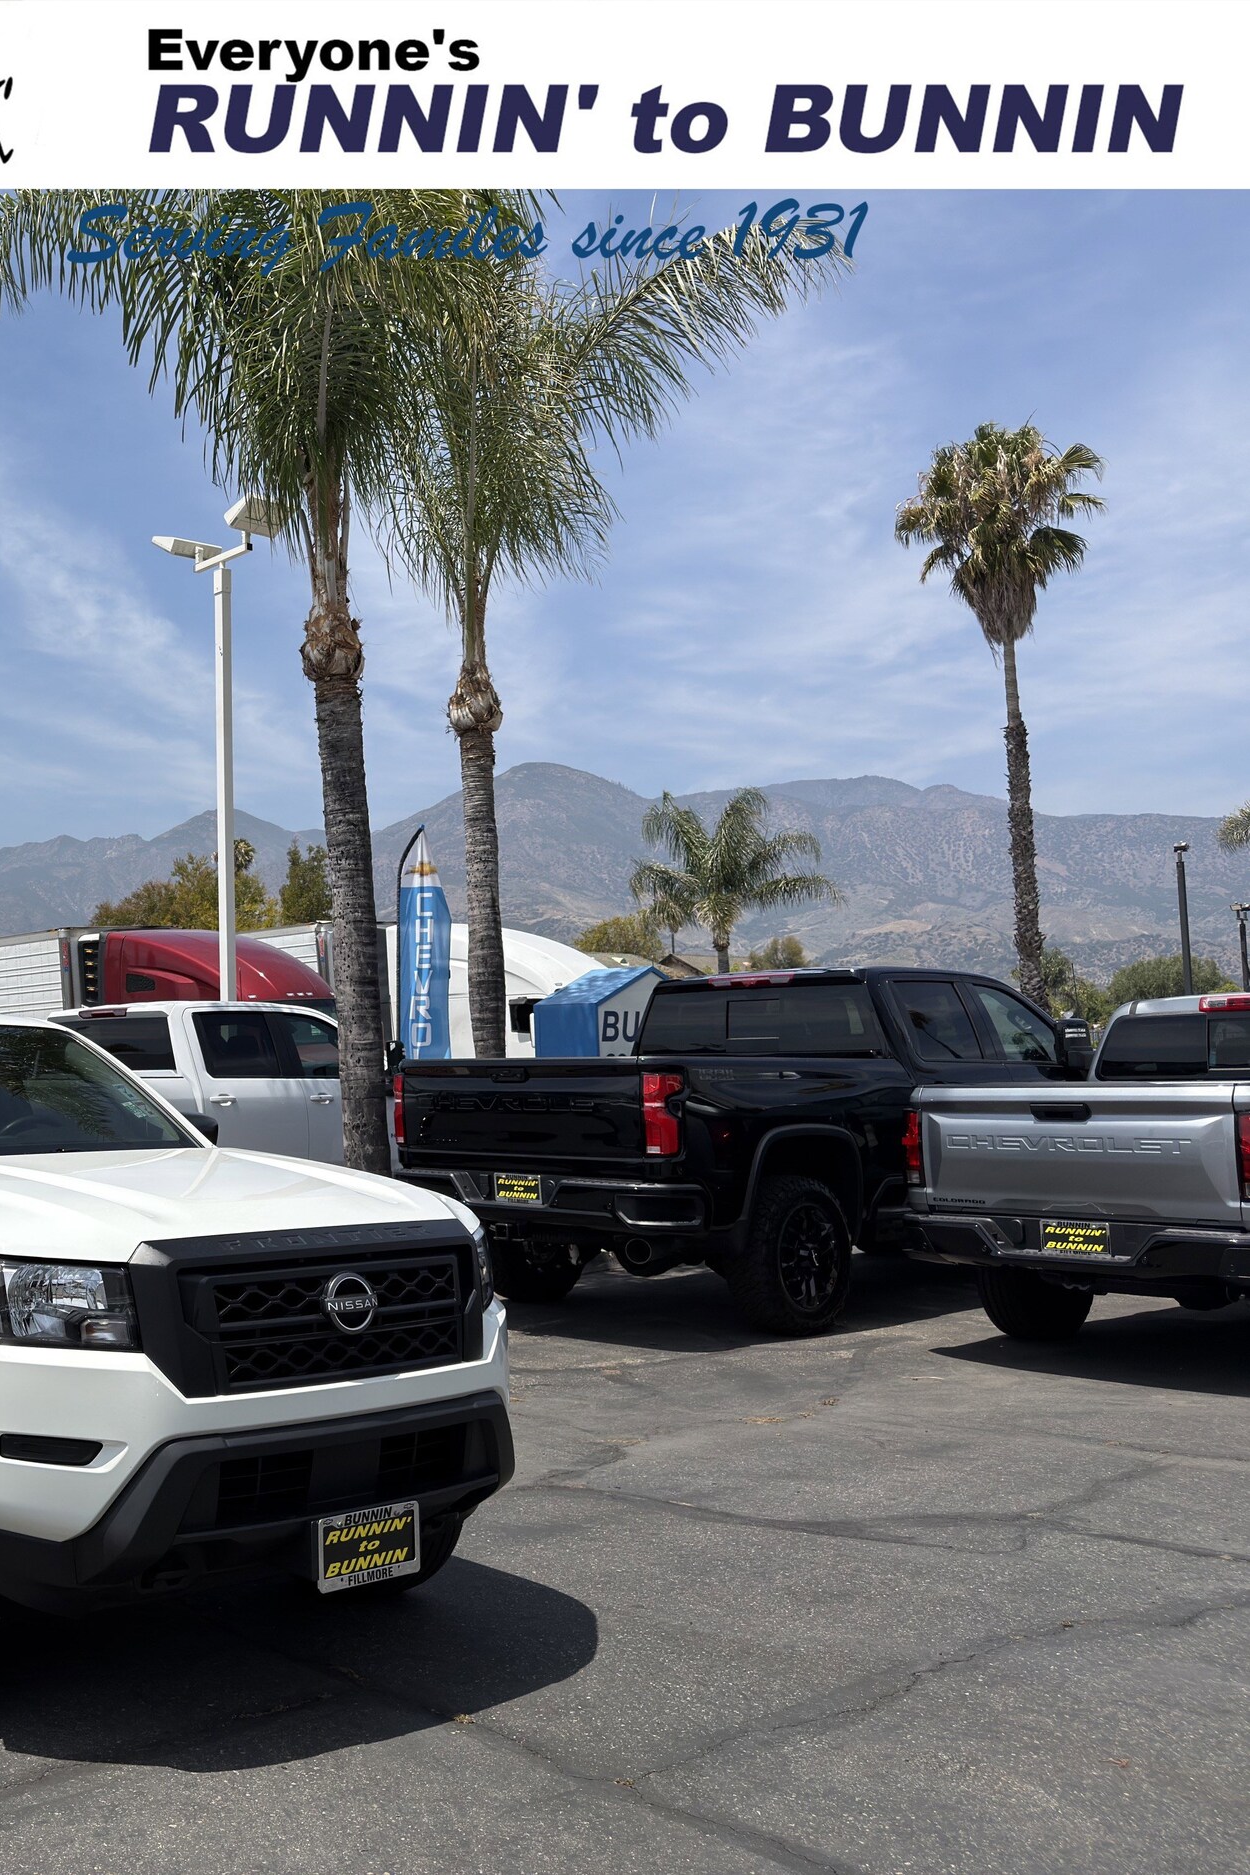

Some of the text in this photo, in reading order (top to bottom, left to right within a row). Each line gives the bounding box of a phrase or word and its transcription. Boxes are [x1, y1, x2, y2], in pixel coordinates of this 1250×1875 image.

[946, 1134, 1192, 1155] CHEVROLET
[497, 1178, 539, 1187] RUNNIN'
[498, 1190, 538, 1200] BUNNIN
[933, 1196, 986, 1205] COLORADO
[219, 1225, 432, 1251] FRONTIER
[1044, 1226, 1107, 1237] RUNNIN'
[1045, 1241, 1105, 1252] BUNNIN
[327, 1298, 378, 1312] NISSAN
[344, 1506, 392, 1526] BUNNIN
[325, 1516, 412, 1546] RUNNIN'
[358, 1540, 381, 1552] to
[325, 1546, 409, 1579] BUNNIN
[348, 1566, 394, 1586] FILLMORE
